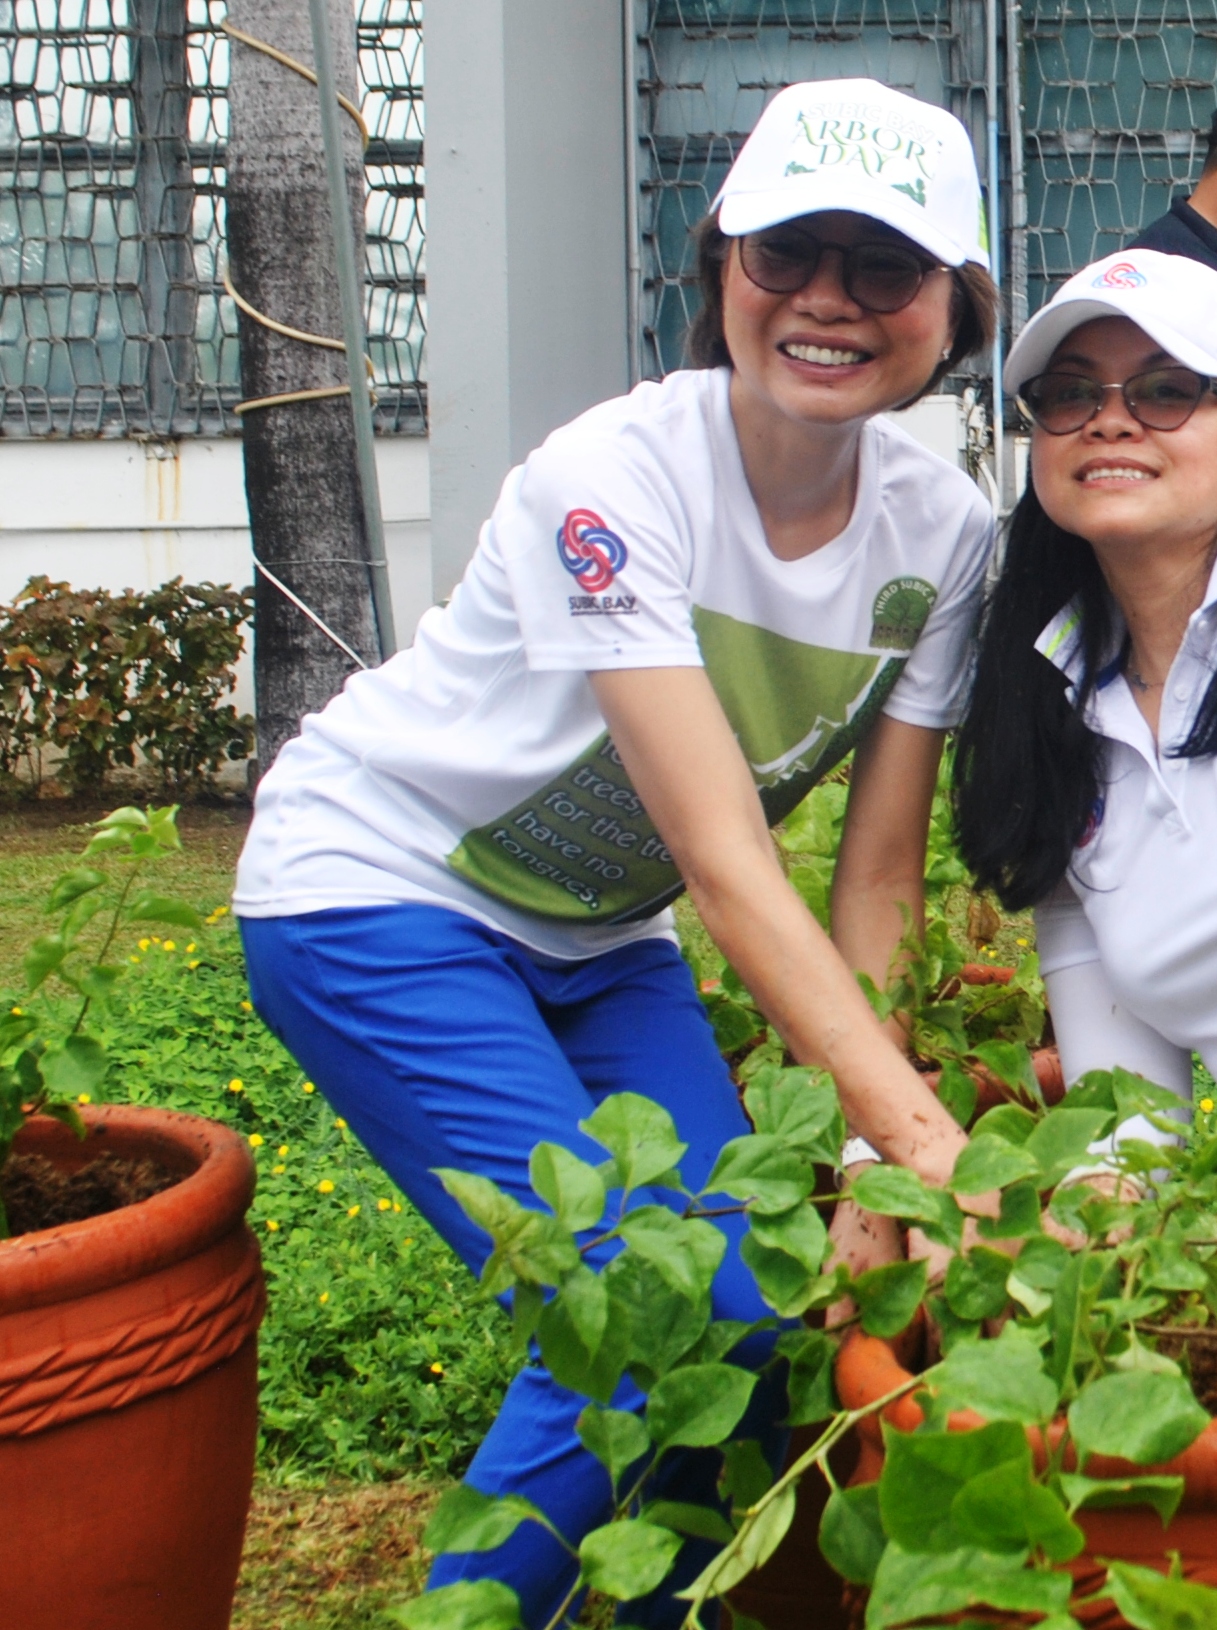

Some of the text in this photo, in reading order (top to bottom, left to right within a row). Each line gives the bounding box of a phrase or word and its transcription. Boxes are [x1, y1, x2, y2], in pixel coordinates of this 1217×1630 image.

[792, 109, 935, 181] ARBOR
[806, 102, 934, 142] SUBIC BAY
[818, 143, 895, 179] DAY
[602, 596, 636, 610] BAY
[514, 810, 625, 880] have no
[544, 791, 674, 862] for the tre
[492, 829, 598, 908] tongues.
